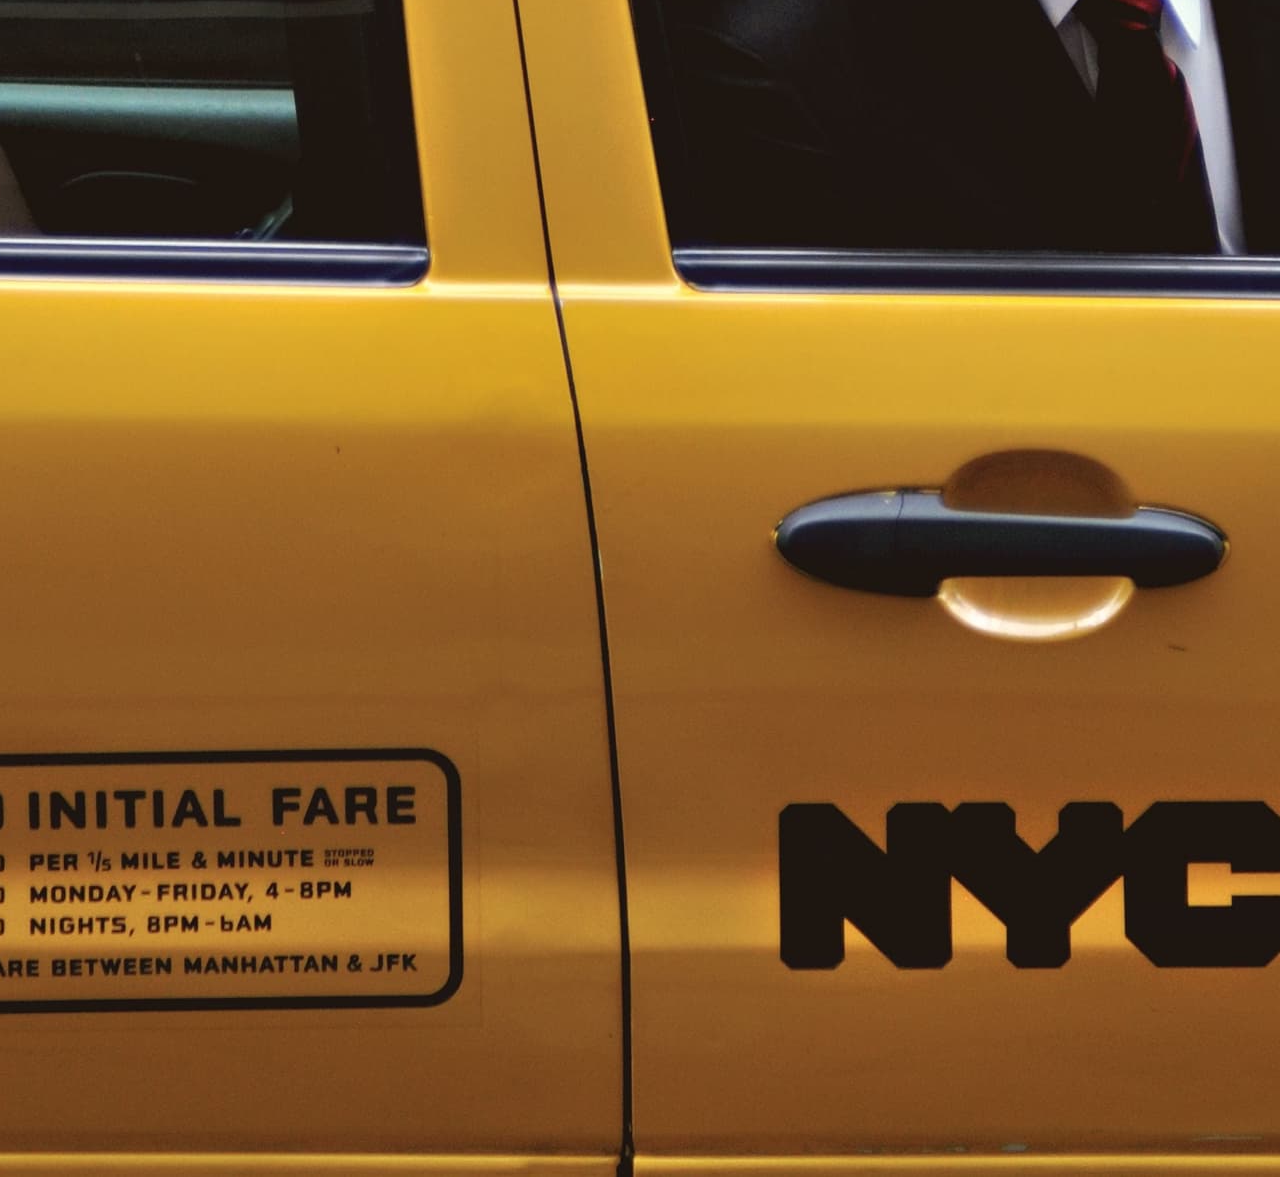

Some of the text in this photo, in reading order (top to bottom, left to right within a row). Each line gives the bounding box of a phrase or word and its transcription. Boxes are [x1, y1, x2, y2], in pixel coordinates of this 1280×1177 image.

[27, 787, 243, 831] INITIAL
[271, 785, 417, 827] FARE
[28, 852, 79, 872] PER
[120, 850, 181, 871] MILE
[190, 850, 208, 871] &
[216, 848, 315, 869] MINUTE
[29, 915, 135, 938] NIGHTS,
[51, 955, 173, 978] BETWEEN
[183, 953, 339, 975] MANHATTAN
[346, 953, 363, 974] &
[369, 952, 418, 973] JFK
